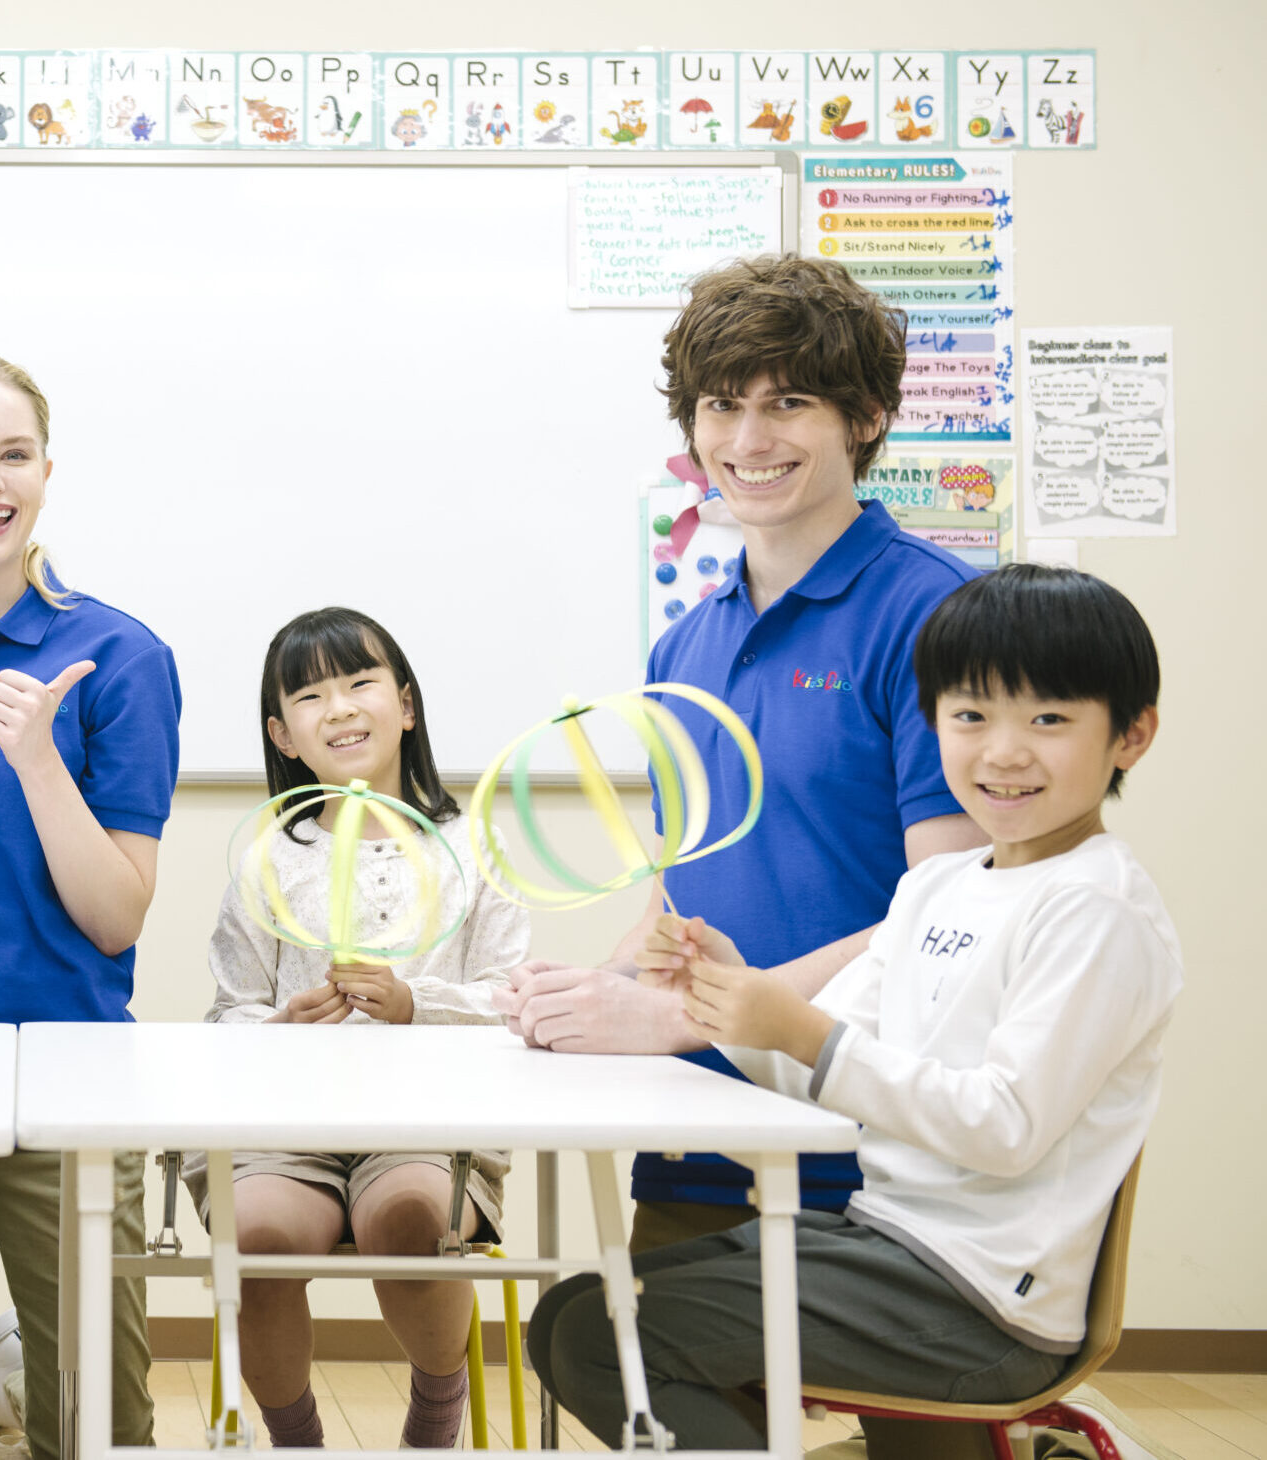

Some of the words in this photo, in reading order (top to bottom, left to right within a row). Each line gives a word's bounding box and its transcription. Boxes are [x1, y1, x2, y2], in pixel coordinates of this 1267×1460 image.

[183, 57, 222, 82] Nn
[250, 56, 293, 83] Oo
[322, 57, 360, 95] Pp
[394, 61, 439, 98] Qq
[467, 61, 504, 86] Rr
[533, 60, 570, 86] Ss
[605, 60, 640, 85] Tt
[681, 56, 721, 82] Uu
[751, 56, 789, 82] Vv
[815, 56, 870, 81] Ww
[892, 56, 930, 81] Xx
[968, 59, 1009, 96] Yy
[1042, 58, 1078, 85] Zz
[813, 164, 898, 181] Elementary
[903, 164, 956, 178] RULES!
[825, 192, 832, 206] 1
[843, 193, 861, 204] No
[862, 193, 912, 207] Running
[915, 195, 926, 204] or
[825, 216, 832, 229] 2
[844, 217, 866, 228] Ask
[875, 218, 888, 228] to
[891, 219, 921, 228] cross
[924, 217, 943, 228] the
[946, 217, 966, 228] red
[843, 241, 905, 253] Sit/Stand
[908, 241, 946, 255] Nicely
[870, 265, 888, 276] An
[891, 265, 934, 276] Indoor
[938, 265, 973, 276] Voice
[913, 290, 957, 301] Others
[938, 313, 991, 325] Yourself
[1027, 340, 1080, 353] Beginner
[1083, 339, 1113, 350] class
[1116, 339, 1130, 350] to
[1030, 353, 1106, 365] Intermediate
[1108, 353, 1138, 364] class
[1143, 352, 1168, 367] goal
[935, 362, 957, 372] The
[960, 362, 990, 375] Toys
[901, 387, 928, 397] eak
[932, 387, 975, 400] English
[909, 411, 930, 420] The
[935, 410, 985, 421] Teacher
[868, 467, 934, 483] ENTARY
